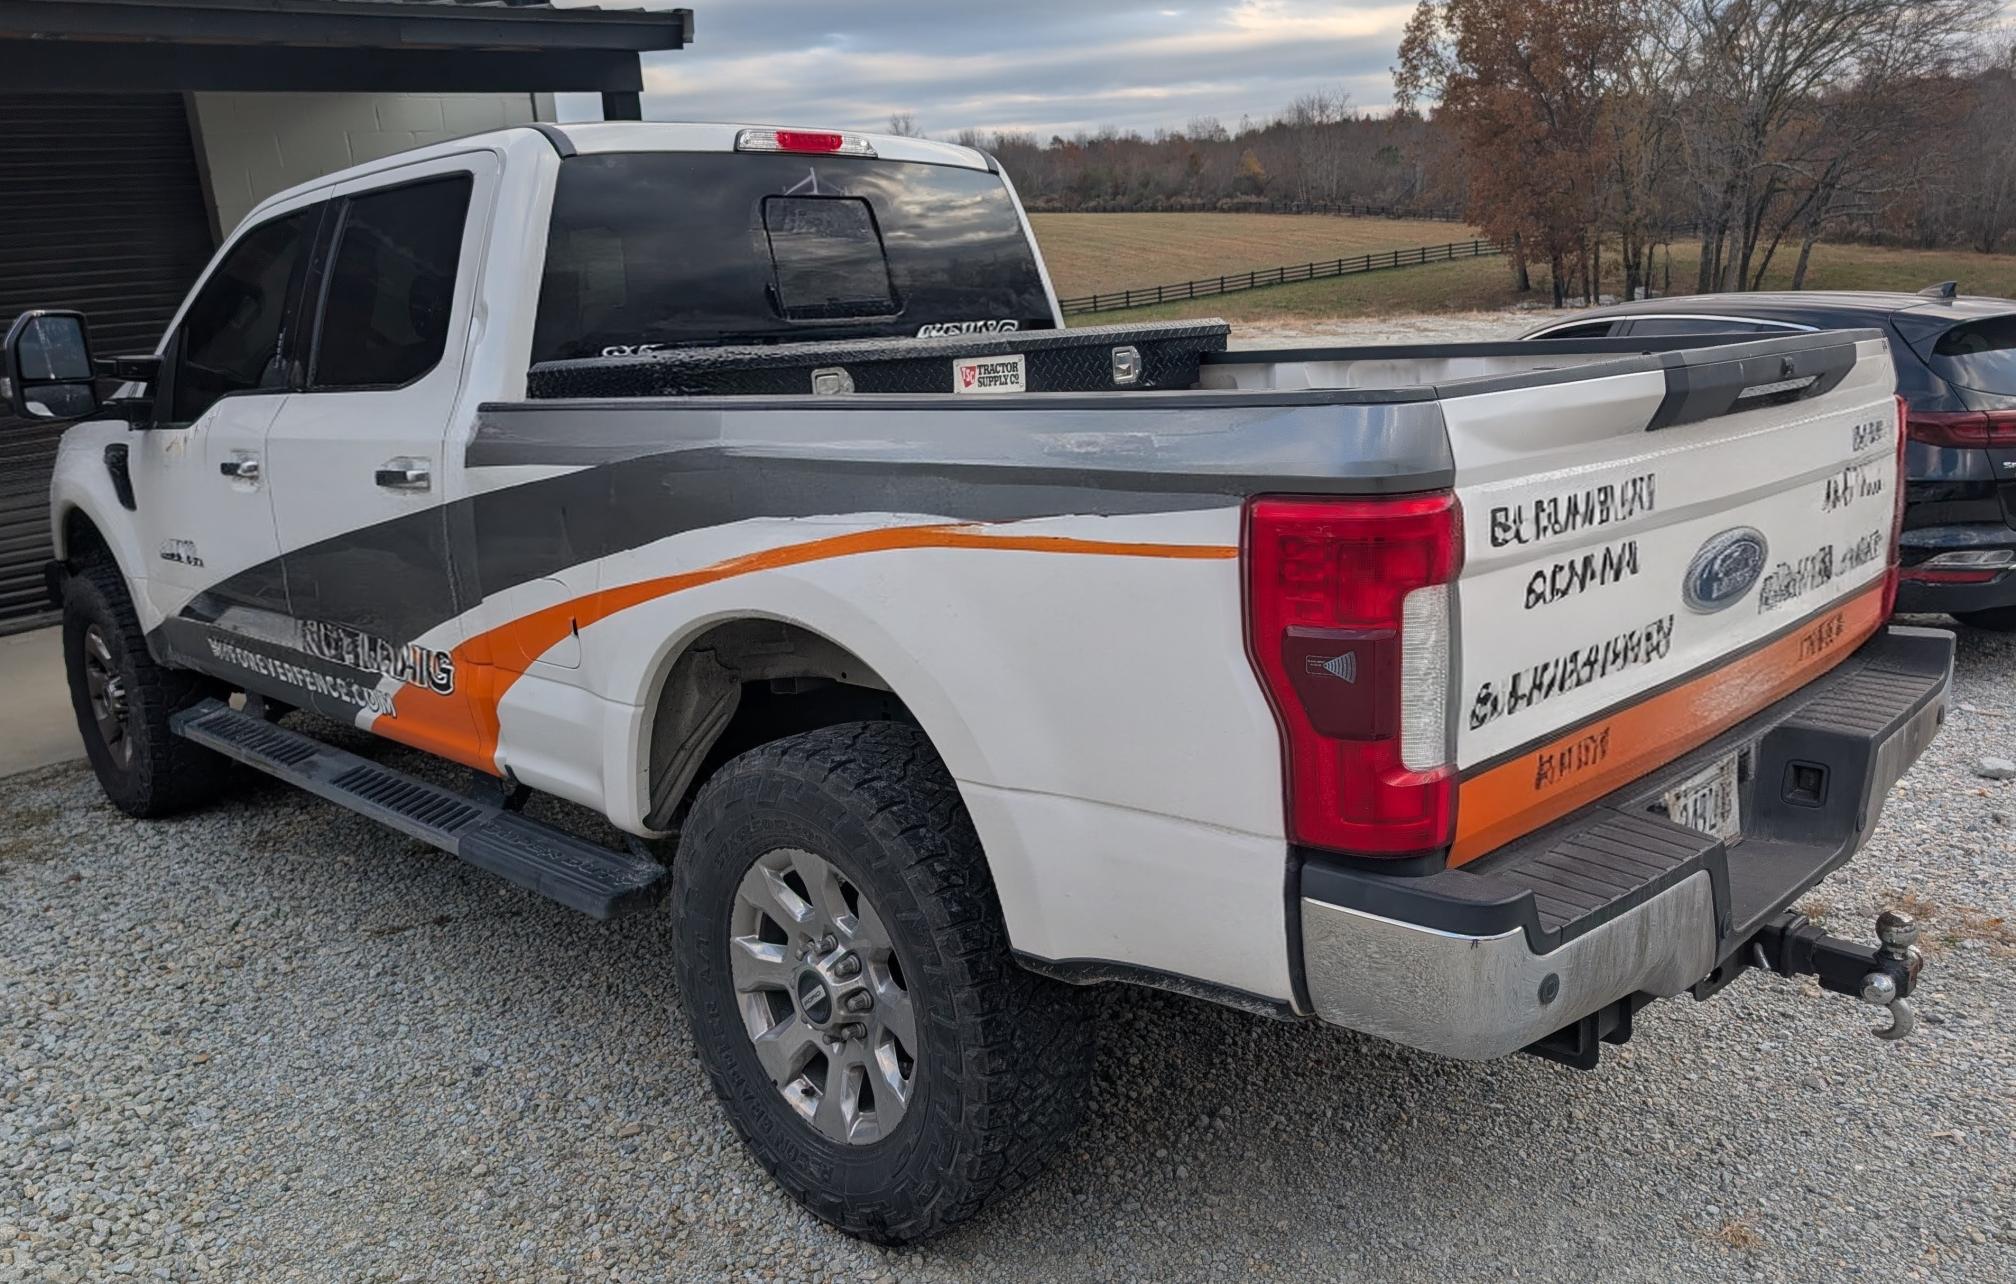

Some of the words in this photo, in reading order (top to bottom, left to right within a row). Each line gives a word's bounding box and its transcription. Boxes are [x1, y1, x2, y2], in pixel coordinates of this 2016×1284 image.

[961, 366, 975, 384] TSC
[977, 361, 1018, 375] TRACTOR
[977, 374, 1009, 387] SUPPLY
